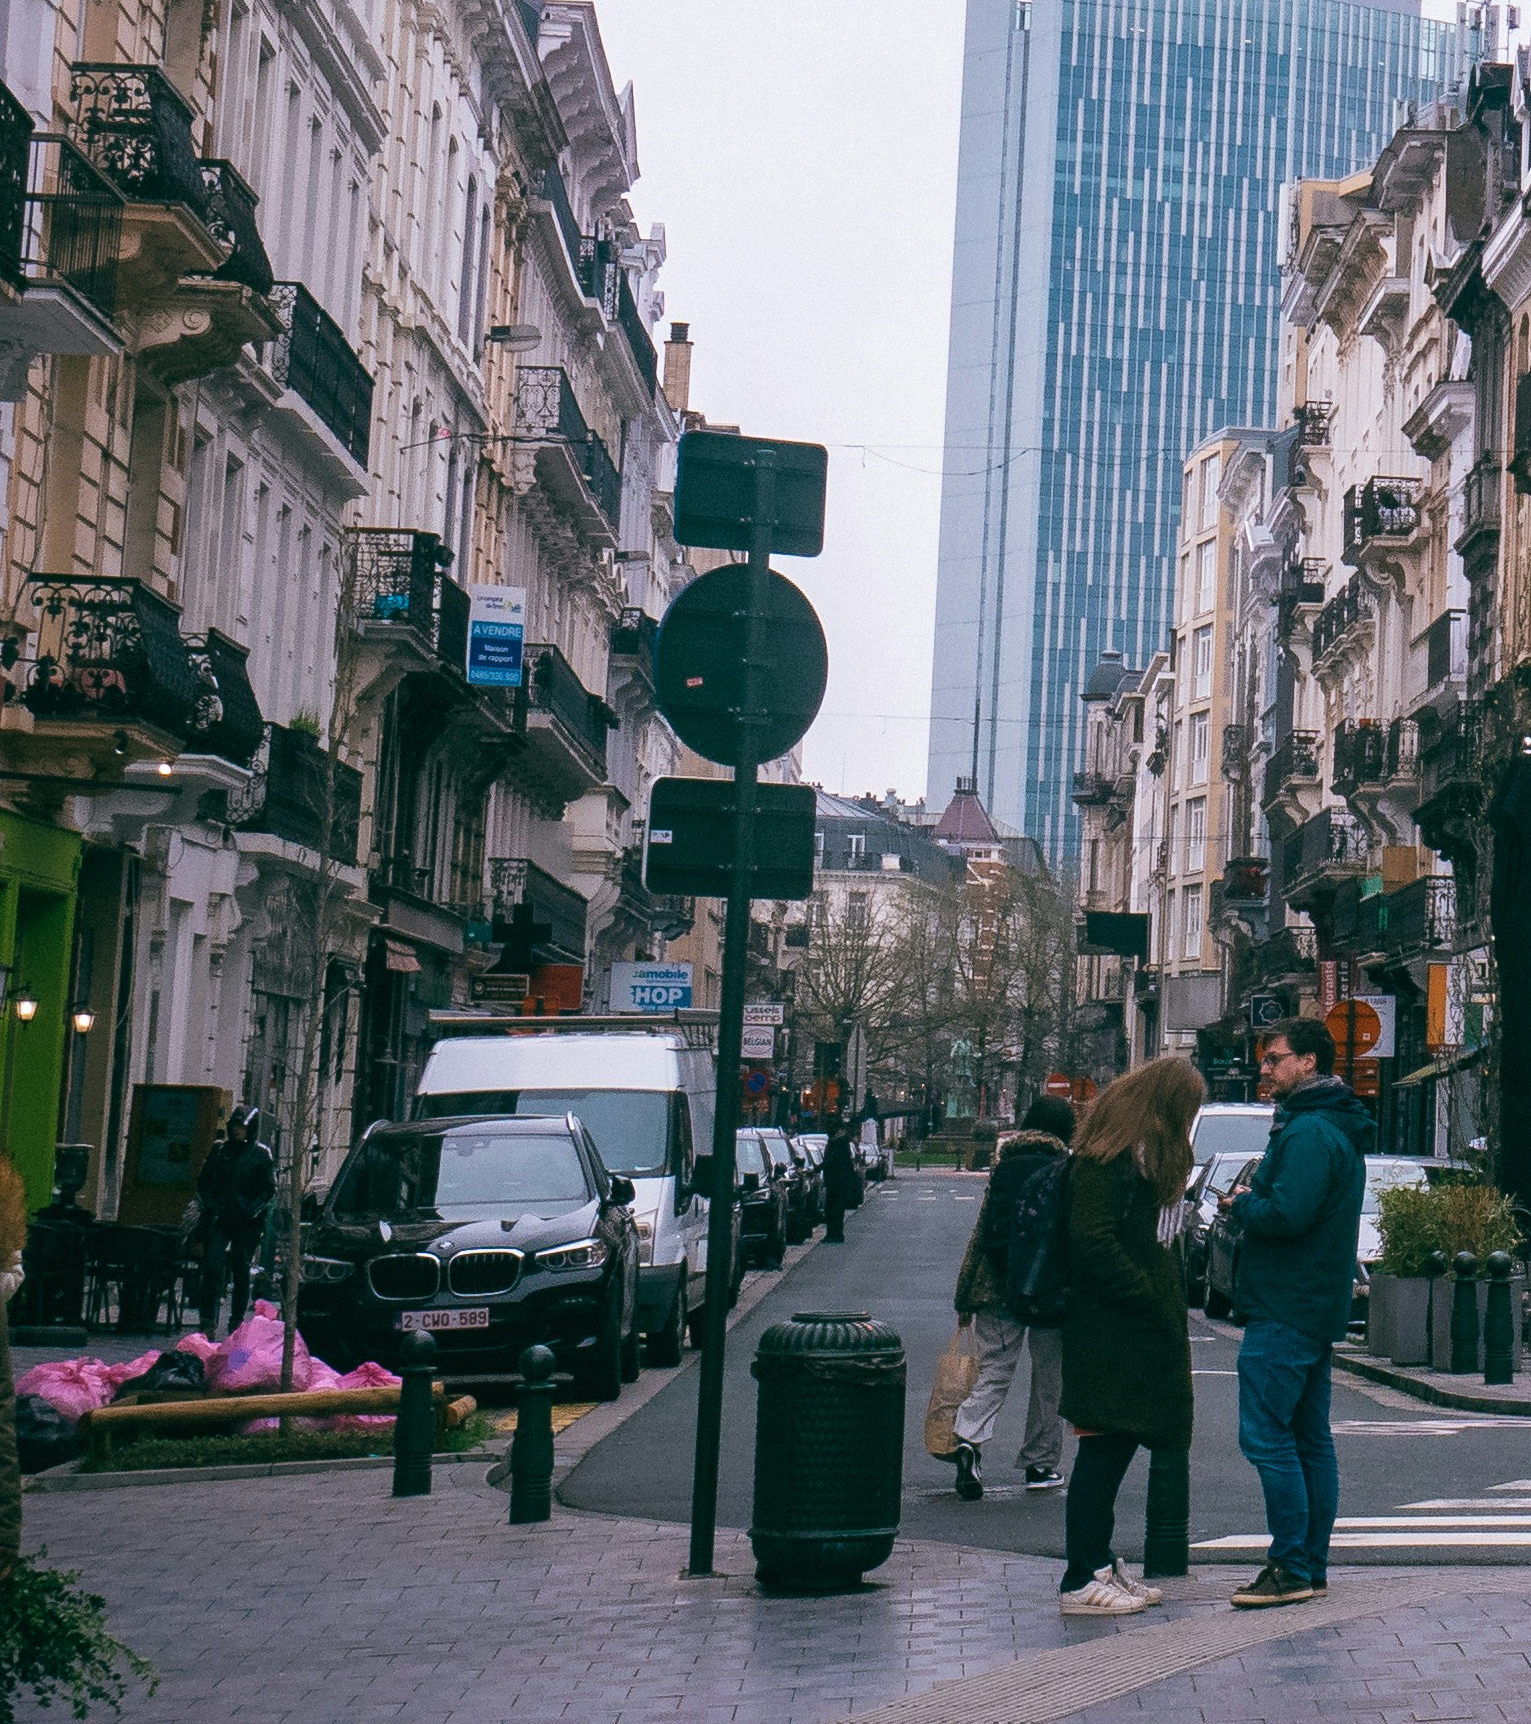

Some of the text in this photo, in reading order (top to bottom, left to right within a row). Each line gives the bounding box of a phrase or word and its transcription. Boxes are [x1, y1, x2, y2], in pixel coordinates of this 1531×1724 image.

[483, 627, 522, 638] VENDRE
[635, 969, 689, 979] amobile
[1325, 961, 1336, 1012] storante
[1340, 961, 1349, 1001] zeria
[744, 1006, 780, 1014] ussels
[743, 1037, 772, 1047] BELGIAN
[403, 1311, 487, 1329] 2-CWO-589
